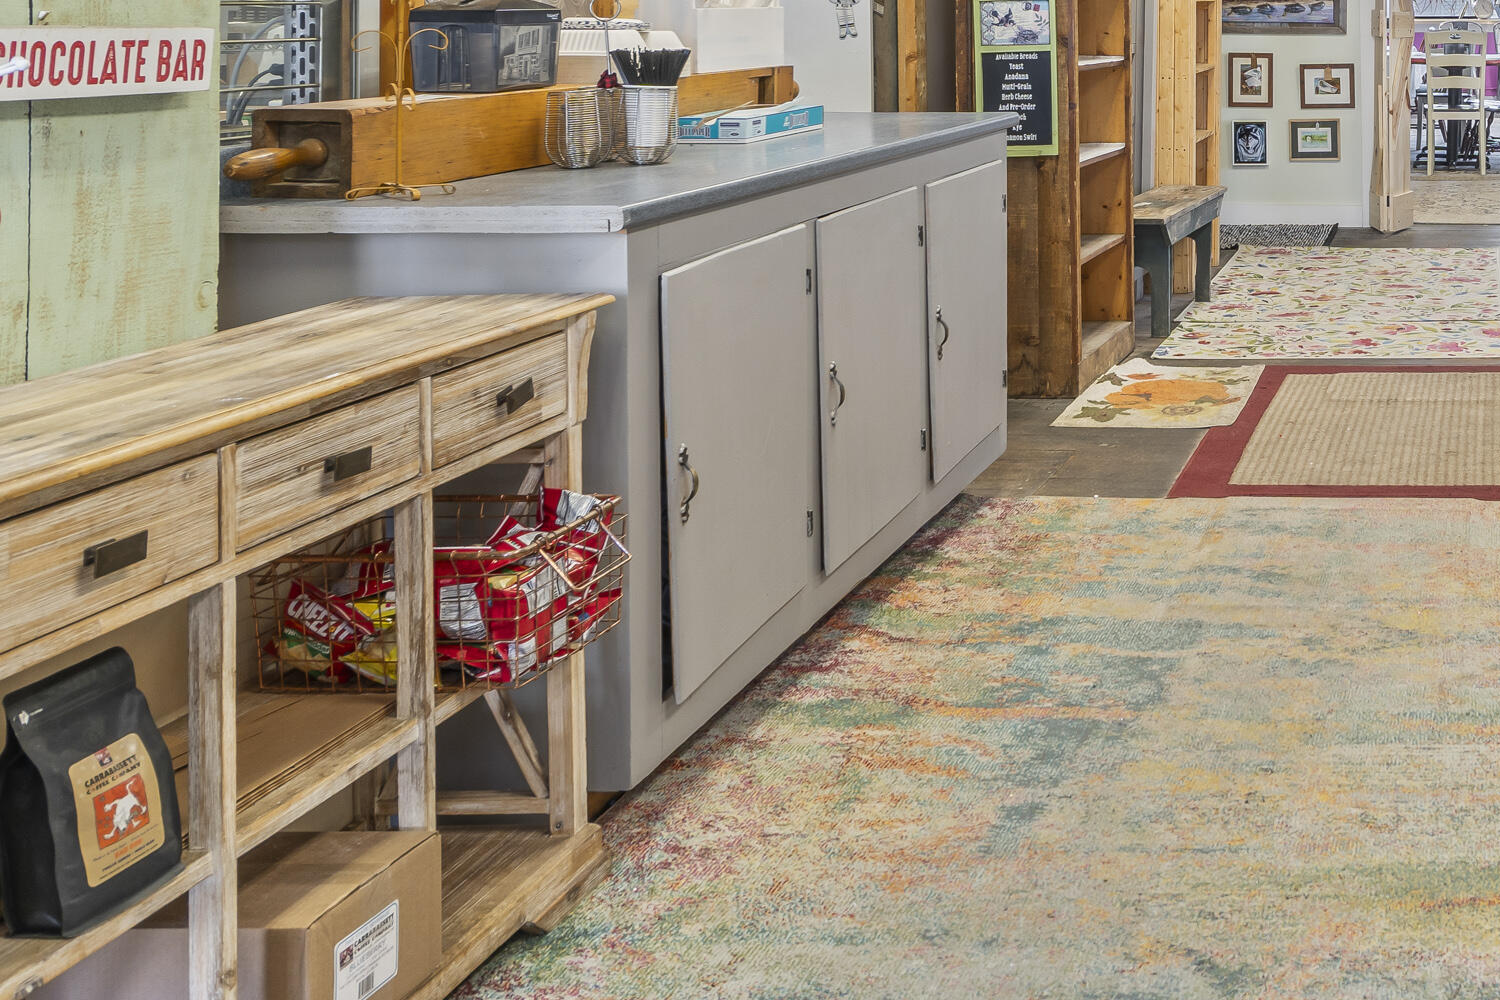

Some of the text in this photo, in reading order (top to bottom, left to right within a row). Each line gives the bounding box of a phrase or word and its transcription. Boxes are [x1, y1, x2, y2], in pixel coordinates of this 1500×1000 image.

[1020, 52, 1038, 60] Breads
[156, 39, 206, 82] BAR
[1015, 93, 1032, 101] Cheese
